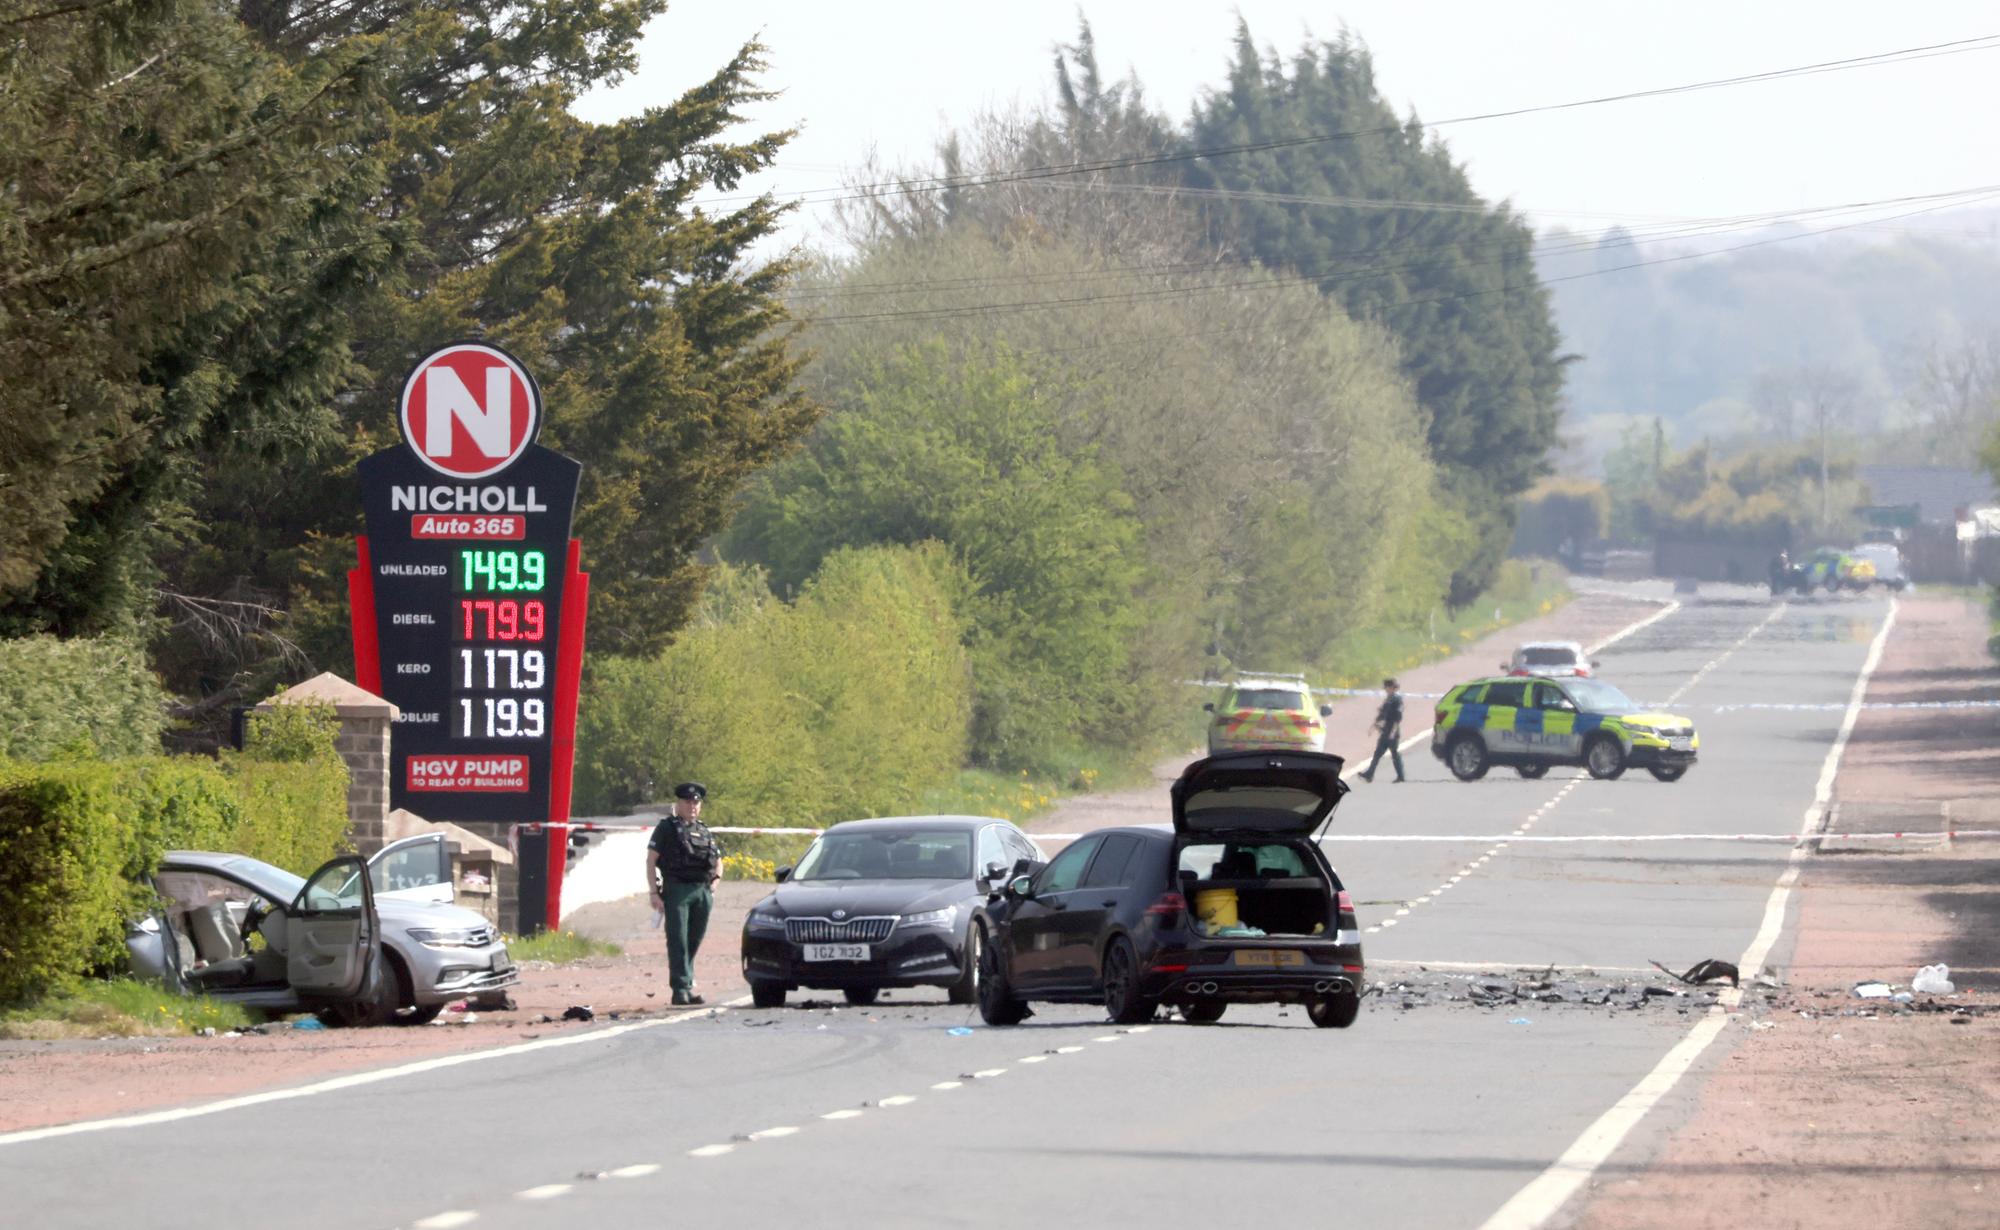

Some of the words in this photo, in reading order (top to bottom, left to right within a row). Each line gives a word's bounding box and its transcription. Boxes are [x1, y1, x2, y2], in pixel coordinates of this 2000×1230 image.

[425, 366, 511, 457] N
[391, 485, 547, 512] NICHOLL
[420, 517, 470, 534] Auto
[473, 518, 515, 535] 365
[380, 564, 447, 576] UNLEADED
[461, 550, 545, 591] 149.9
[392, 614, 435, 625] DIESEL
[461, 600, 545, 640] 179.9
[397, 663, 431, 674] KERO
[391, 712, 440, 723] DBLUE
[412, 761, 458, 776] HGV
[464, 760, 522, 776] PUMP
[429, 778, 453, 787] REAR
[458, 777, 473, 786] OF
[475, 777, 524, 787] BUILDING
